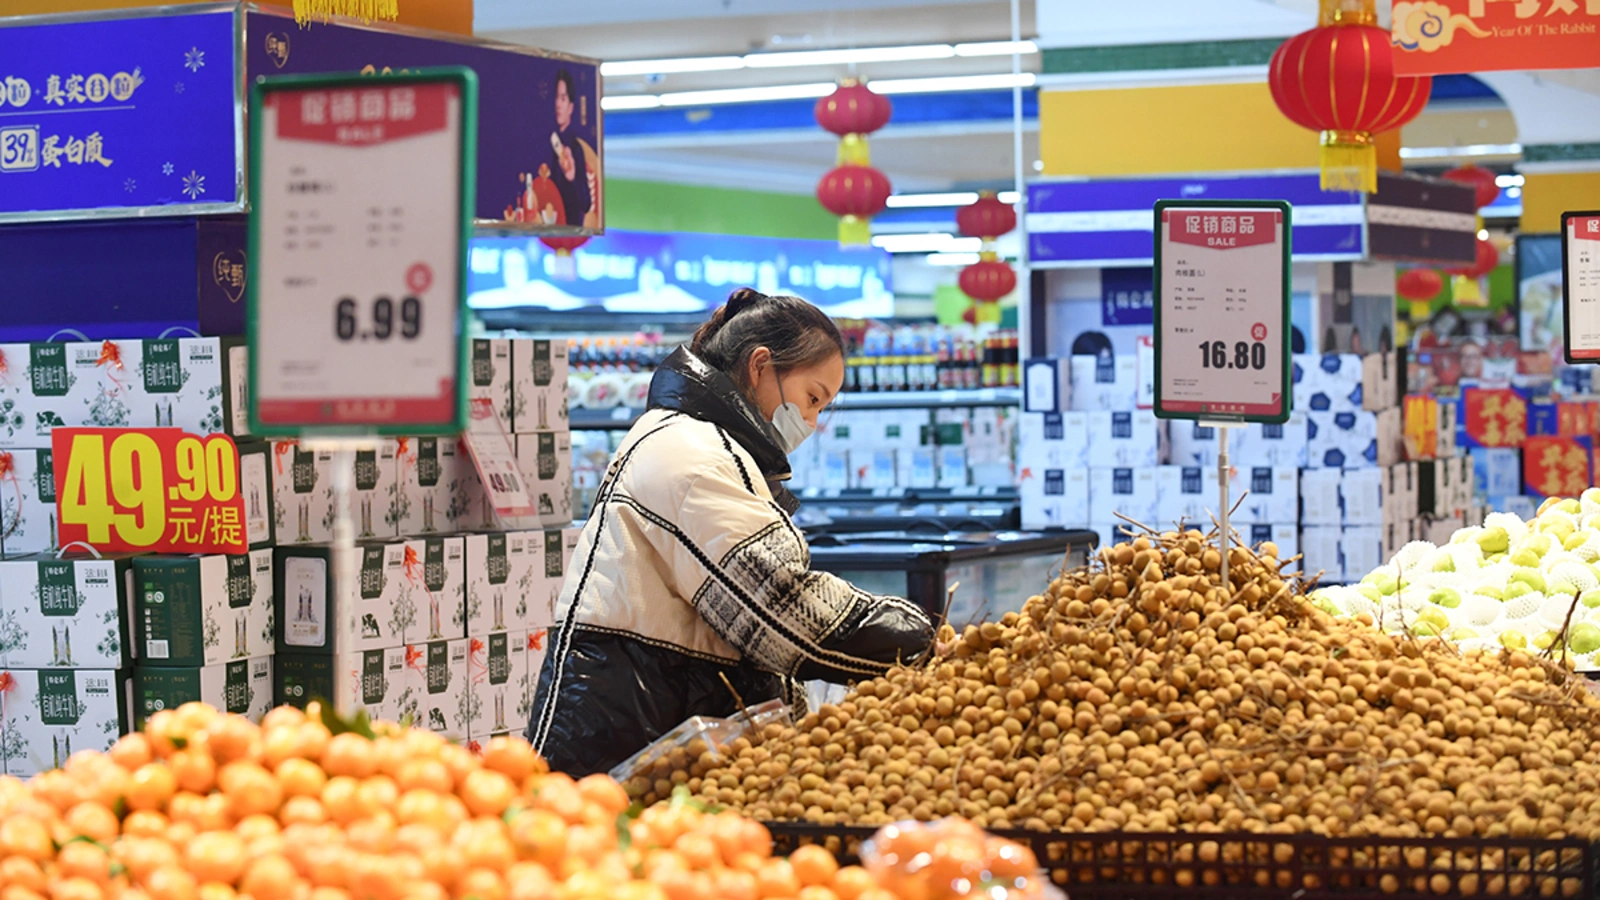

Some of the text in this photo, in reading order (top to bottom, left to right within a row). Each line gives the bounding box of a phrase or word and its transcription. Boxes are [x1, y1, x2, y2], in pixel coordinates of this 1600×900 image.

[1491, 22, 1597, 37] Year Of The Rabbit
[42, 131, 113, 168] 蛋白质
[1185, 215, 1255, 234] 促销商品
[1207, 237, 1236, 246] SALE
[335, 296, 421, 341] 6.99
[1199, 340, 1266, 370] 16.80
[61, 432, 236, 546] 49.90
[168, 506, 242, 545] 元/提
